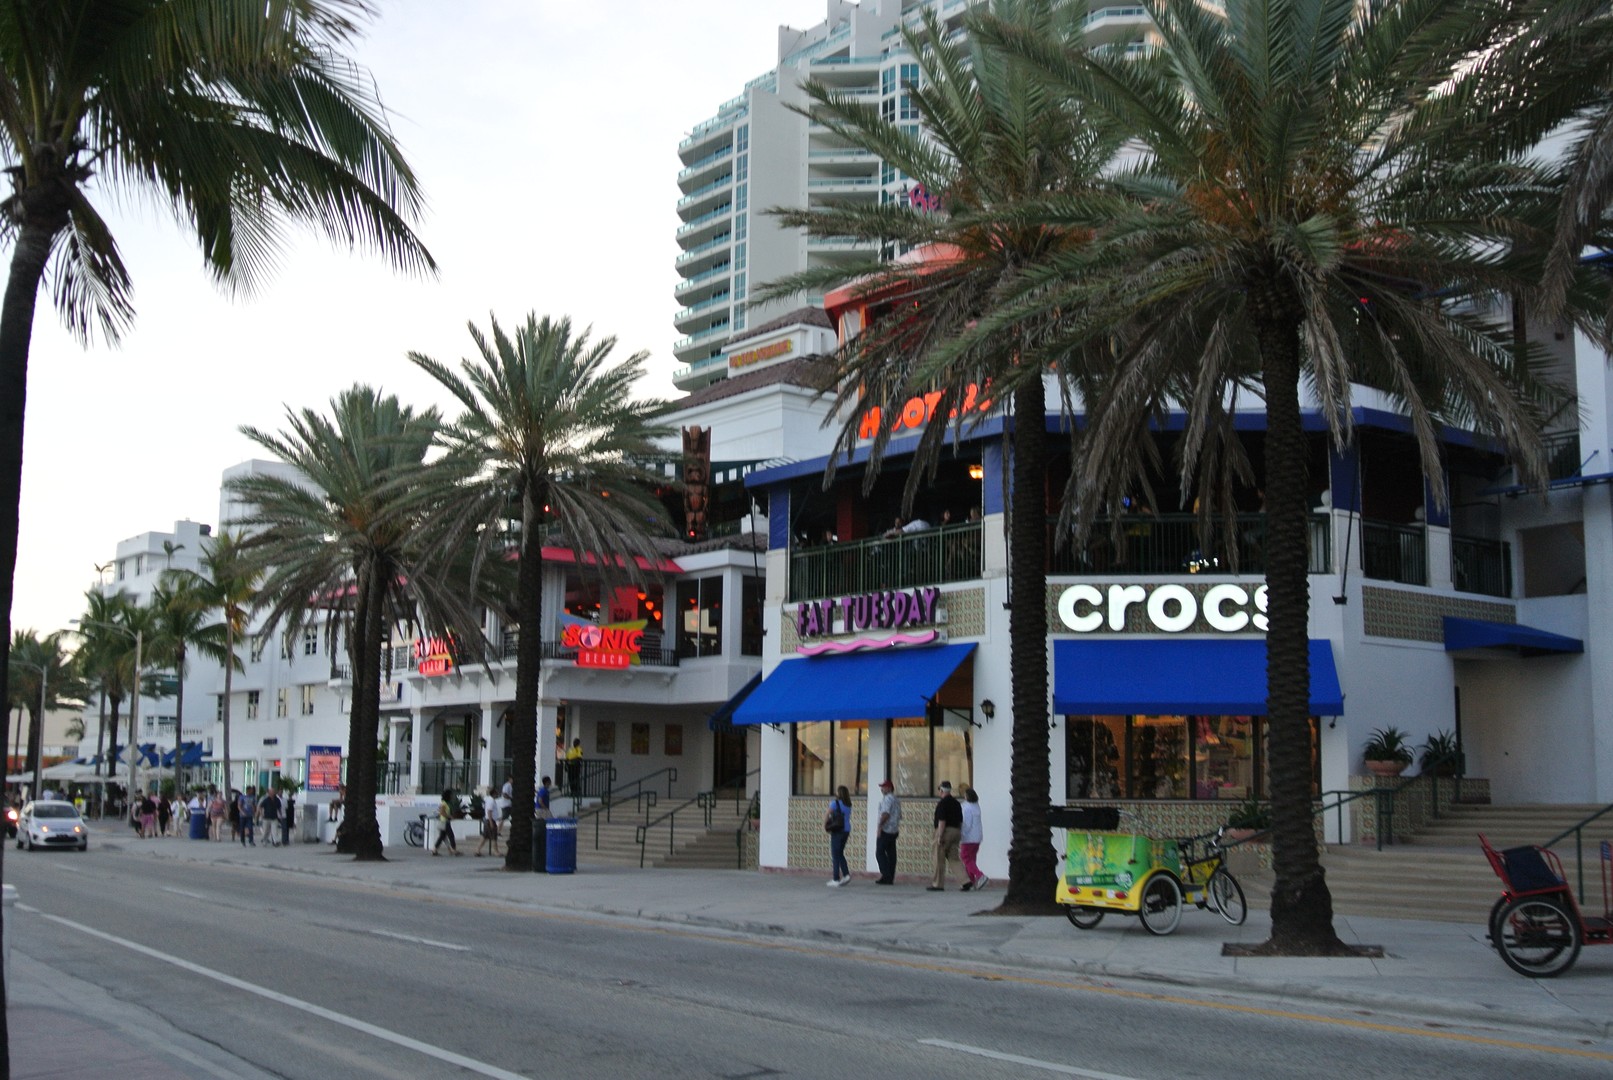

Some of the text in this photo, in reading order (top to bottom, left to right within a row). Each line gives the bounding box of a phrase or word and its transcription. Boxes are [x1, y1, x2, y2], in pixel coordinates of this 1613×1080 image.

[797, 586, 940, 636] FAT TUESDAY
[561, 623, 645, 653] SONIC
[585, 654, 624, 666] BEACH
